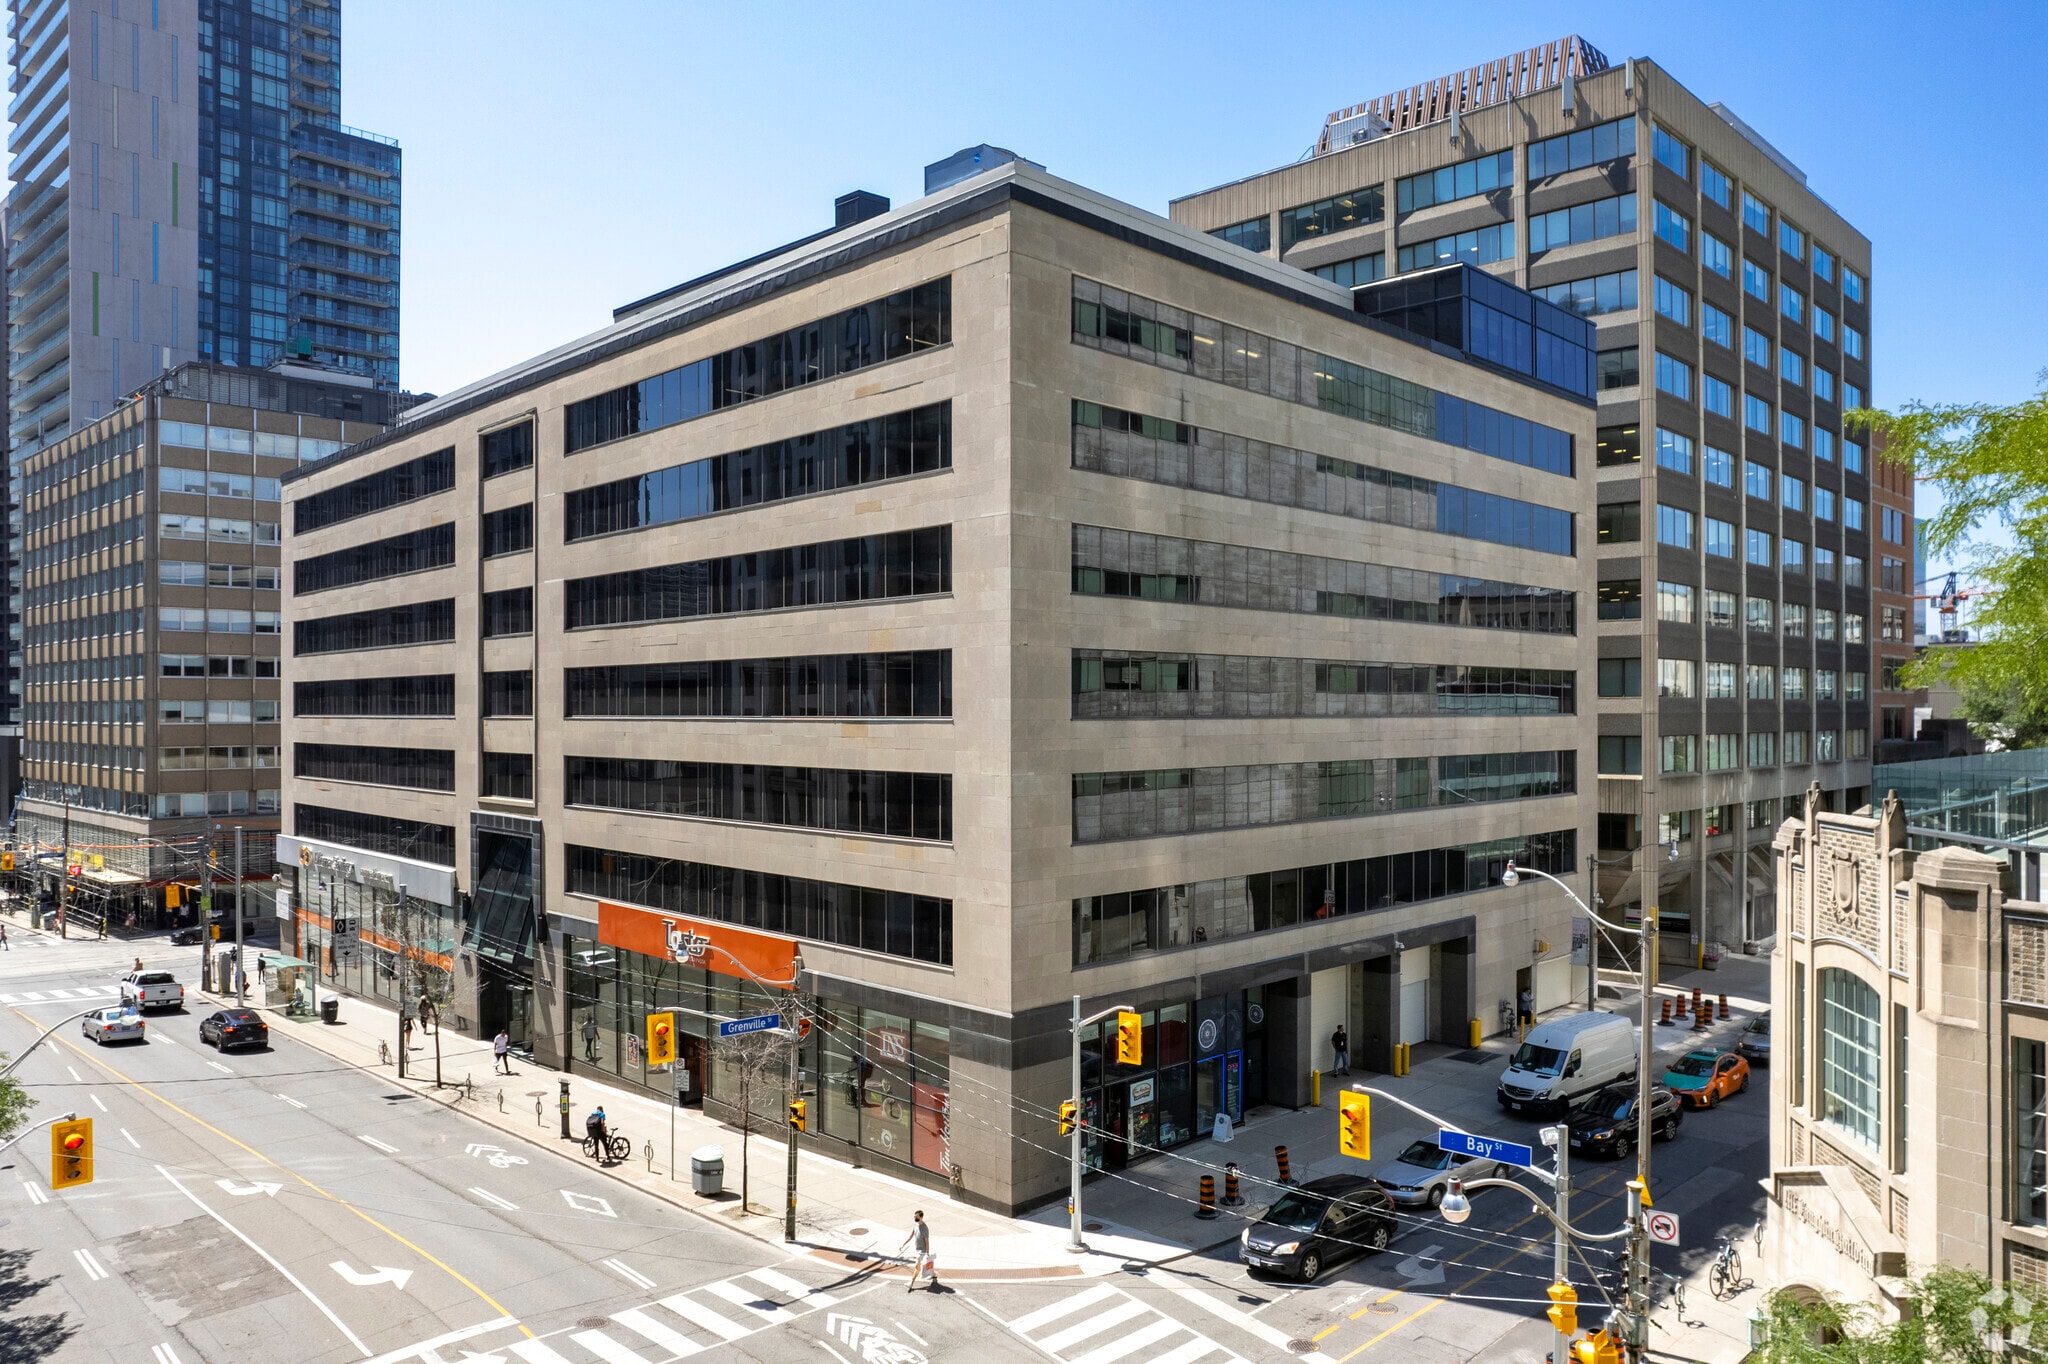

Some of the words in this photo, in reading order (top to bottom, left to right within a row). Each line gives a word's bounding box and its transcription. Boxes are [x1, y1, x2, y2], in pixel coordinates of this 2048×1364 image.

[728, 1018, 767, 1033] Grenville
[1467, 1136, 1493, 1157] Bay
[1495, 1142, 1503, 1151] St
